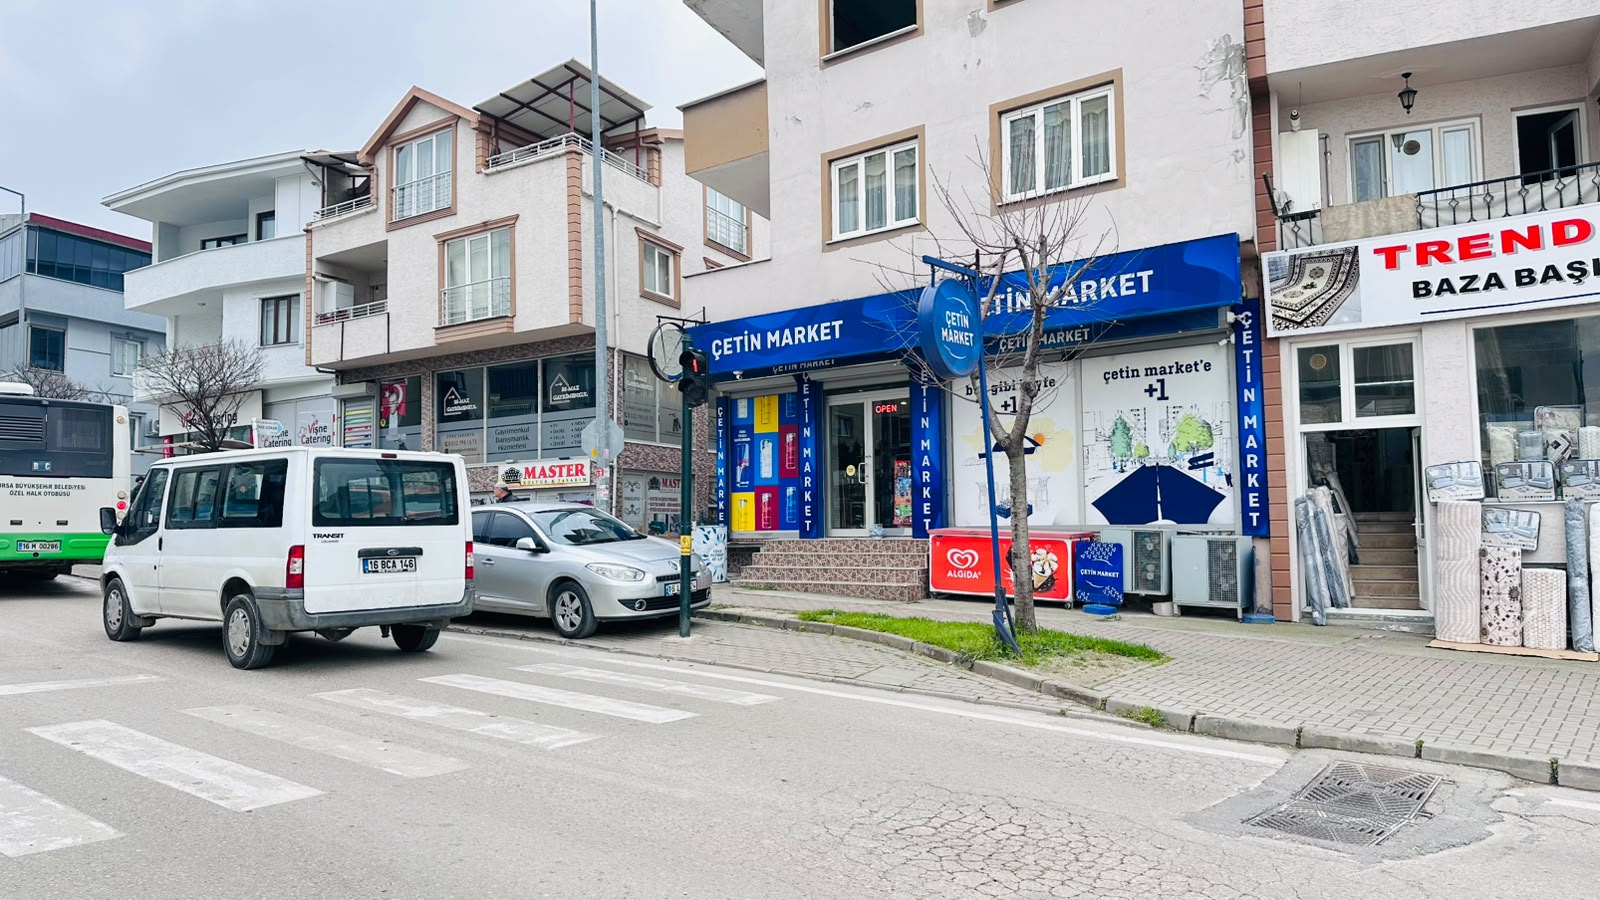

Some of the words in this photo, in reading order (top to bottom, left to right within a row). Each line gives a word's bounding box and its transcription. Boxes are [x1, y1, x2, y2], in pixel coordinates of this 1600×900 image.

[1373, 218, 1596, 271] TREND
[1412, 272, 1507, 299] BAZA
[980, 287, 1032, 317] TİN
[945, 309, 969, 328] ÇETİN
[711, 330, 761, 361] ÇETİN
[766, 319, 844, 349] MARKET
[941, 327, 974, 347] MARKET
[1241, 311, 1257, 402] ÇETİN
[1103, 367, 1140, 385] çetin
[1144, 359, 1213, 379] market'e
[920, 369, 930, 429] ETİN
[1144, 379, 1170, 401] +1
[802, 370, 812, 438] ÇETİN
[875, 403, 899, 414] OPEN
[1000, 396, 1019, 414] +1
[300, 433, 331, 445] Catering
[308, 421, 328, 436] Vişne
[716, 406, 725, 460] ÇETİN
[263, 437, 292, 449] Catering
[523, 463, 586, 480] MASTER
[1243, 415, 1261, 527] MARKET
[9, 489, 25, 497] ÖZEL
[15, 483, 53, 491] BÜYÜKŞEHİR
[54, 483, 87, 491] BELEDİYESİ
[661, 477, 681, 490] MAST
[803, 447, 812, 532] MARKET
[920, 438, 932, 534] MARKET
[369, 560, 379, 570] 16
[380, 558, 398, 570] BCA
[399, 557, 414, 569] 146
[1080, 568, 1098, 578] ÇETİN
[1099, 569, 1120, 579] MARKET
